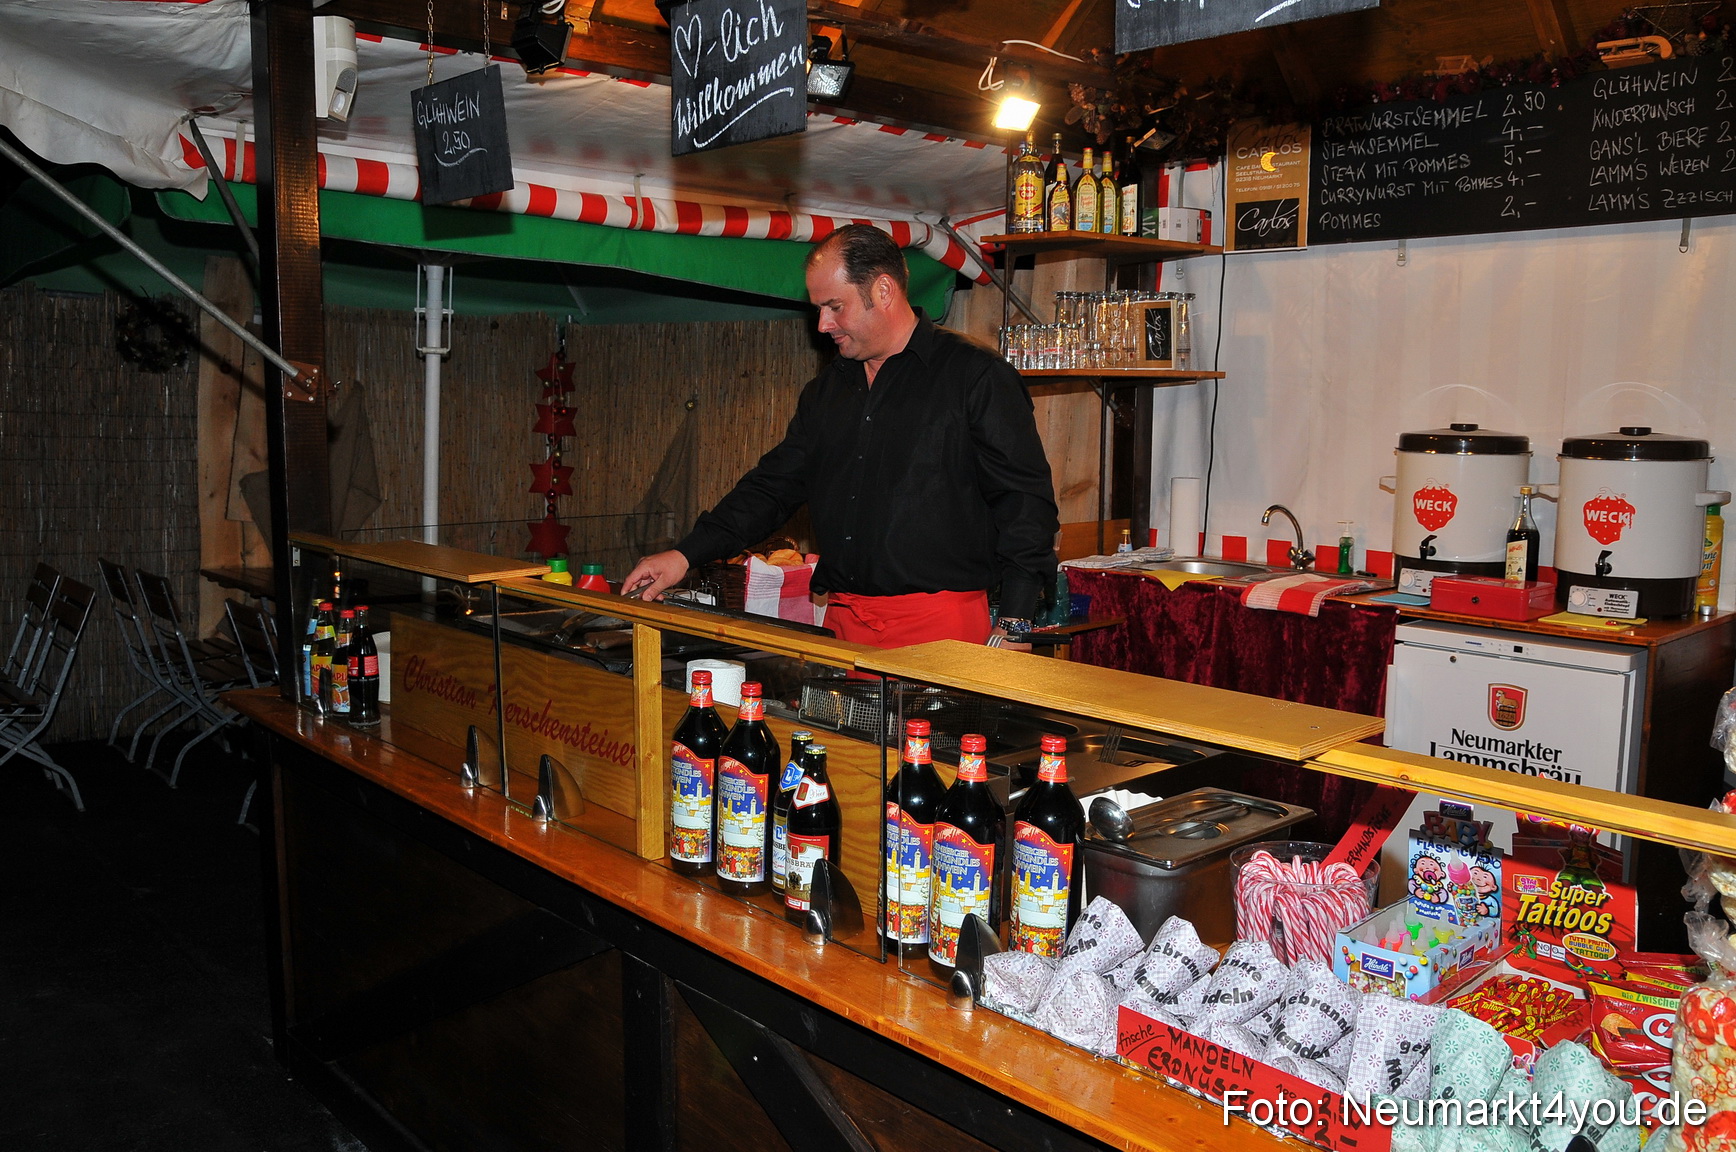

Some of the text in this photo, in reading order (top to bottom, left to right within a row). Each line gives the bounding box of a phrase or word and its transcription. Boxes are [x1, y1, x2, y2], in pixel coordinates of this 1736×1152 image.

[672, 43, 805, 140] Willkommen
[1593, 67, 1698, 100] GLÜHWEIN
[416, 92, 481, 129] GLÜHWEIN
[1322, 100, 1488, 138] BRATWURSTSEMMEL
[1592, 98, 1695, 132] KINDERPUNSCH
[1322, 132, 1440, 161] STEAKSEMMEL
[1656, 126, 1709, 152] BIERE
[1321, 161, 1367, 186] STEAK
[1375, 161, 1398, 180] MIT
[1403, 153, 1472, 174] POMMES
[1659, 153, 1711, 176] WEIZEN
[1320, 182, 1416, 206] CURRYWURST
[1422, 180, 1450, 197] MIT
[1455, 175, 1504, 193] POMMES
[1237, 198, 1300, 238] Carlos
[1319, 211, 1381, 231] POMMES
[1415, 498, 1452, 513] WECK
[1586, 508, 1631, 525] WECK
[403, 654, 476, 710] Christian
[1451, 728, 1562, 763] Neumarkter
[1430, 741, 1581, 786] Lammsbräu
[1423, 811, 1494, 847] BABY
[1548, 881, 1608, 906] Super
[1516, 893, 1613, 935] Tattoos
[1537, 942, 1550, 951] NO
[1568, 935, 1610, 948] TUTTI FRUTTI
[1569, 941, 1594, 950] BUBBLE
[1575, 947, 1609, 960] TATTOOS
[1118, 1024, 1255, 1080] frische MANDELN
